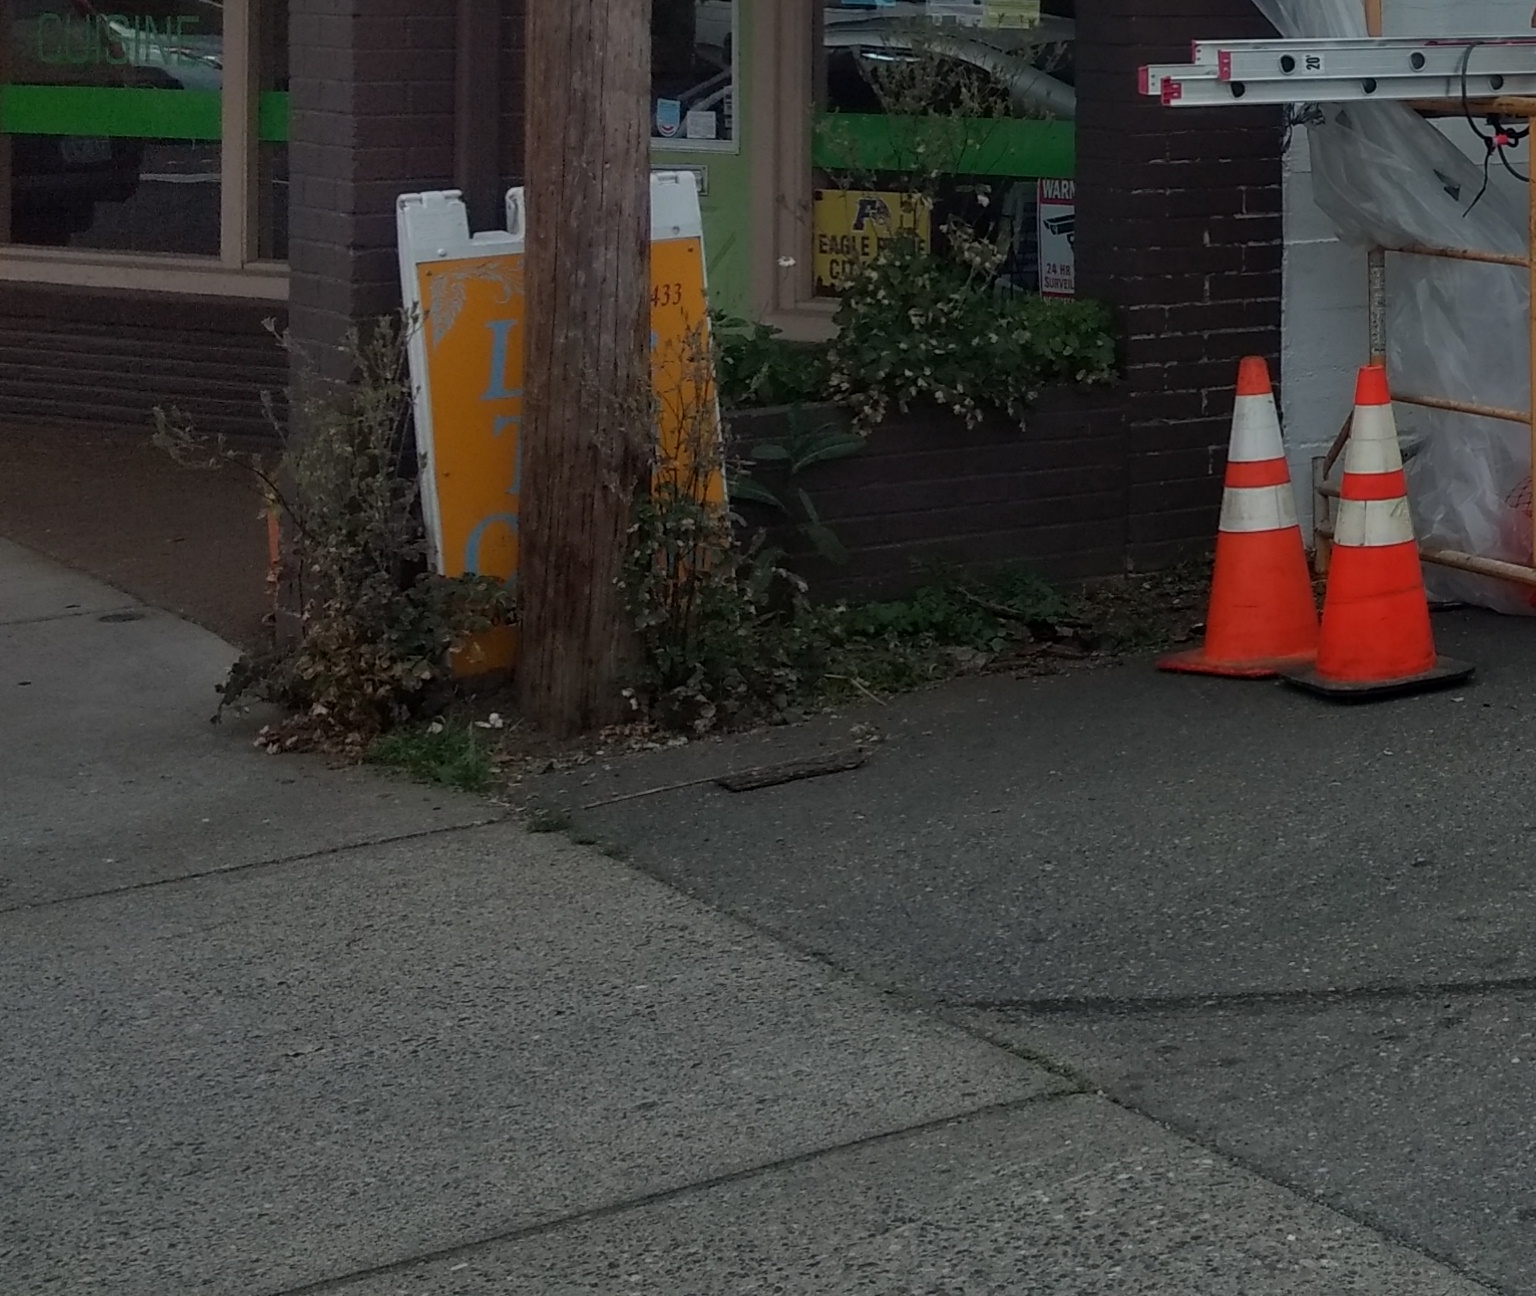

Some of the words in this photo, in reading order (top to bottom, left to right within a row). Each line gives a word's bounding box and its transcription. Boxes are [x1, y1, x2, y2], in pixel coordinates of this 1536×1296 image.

[36, 12, 200, 66] CUISINE
[818, 234, 870, 256] EAGLE
[1046, 263, 1057, 274] 24
[1060, 265, 1071, 276] HR
